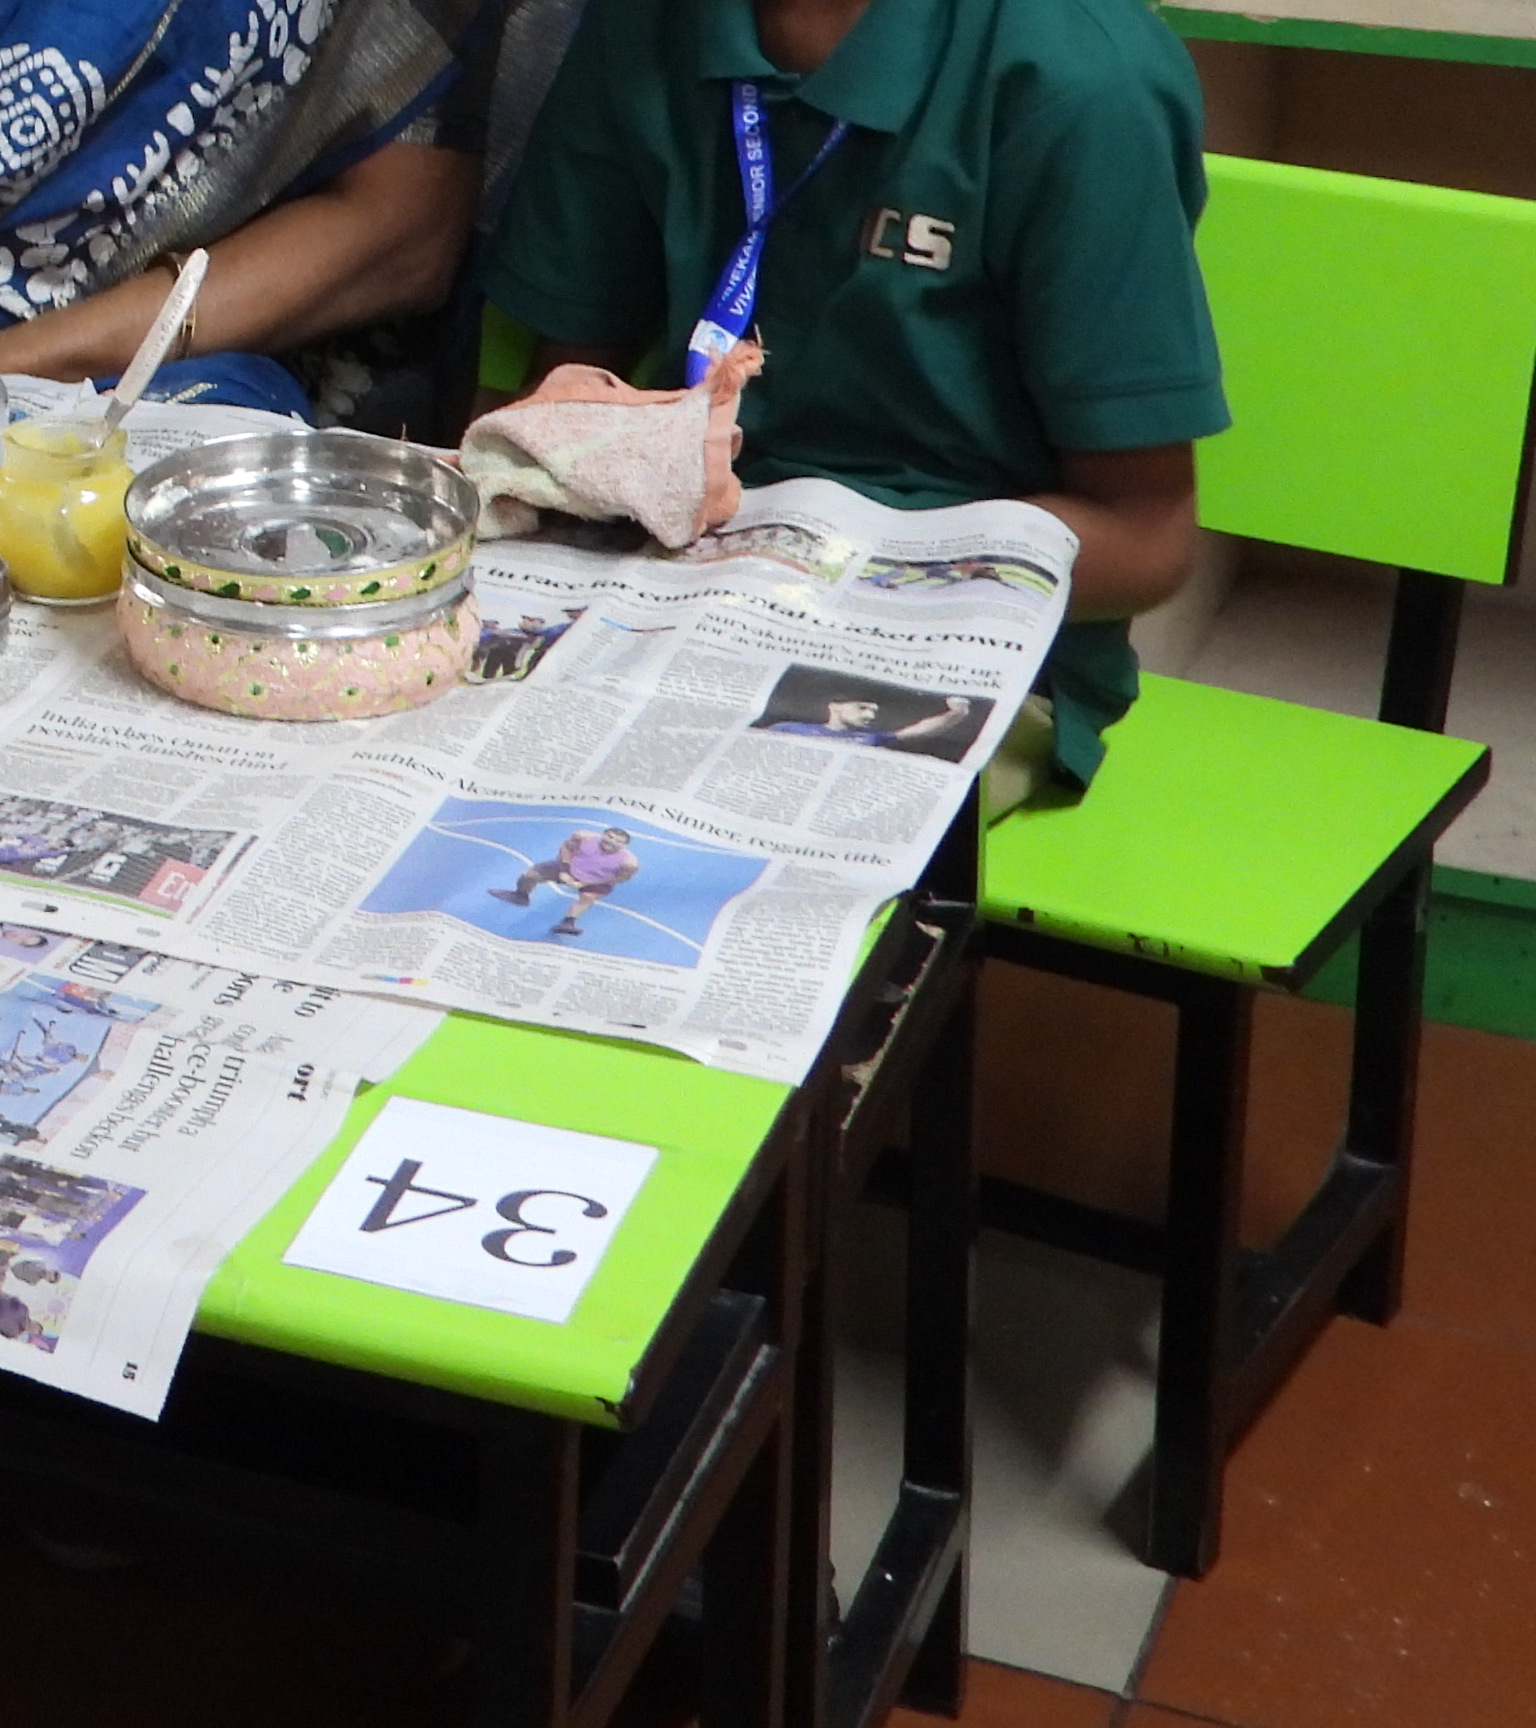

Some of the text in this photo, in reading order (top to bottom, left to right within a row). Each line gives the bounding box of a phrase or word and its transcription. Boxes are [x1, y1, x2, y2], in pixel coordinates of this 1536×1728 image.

[925, 632, 1024, 653] crown
[287, 1063, 315, 1103] ort
[358, 1157, 609, 1267] 34
